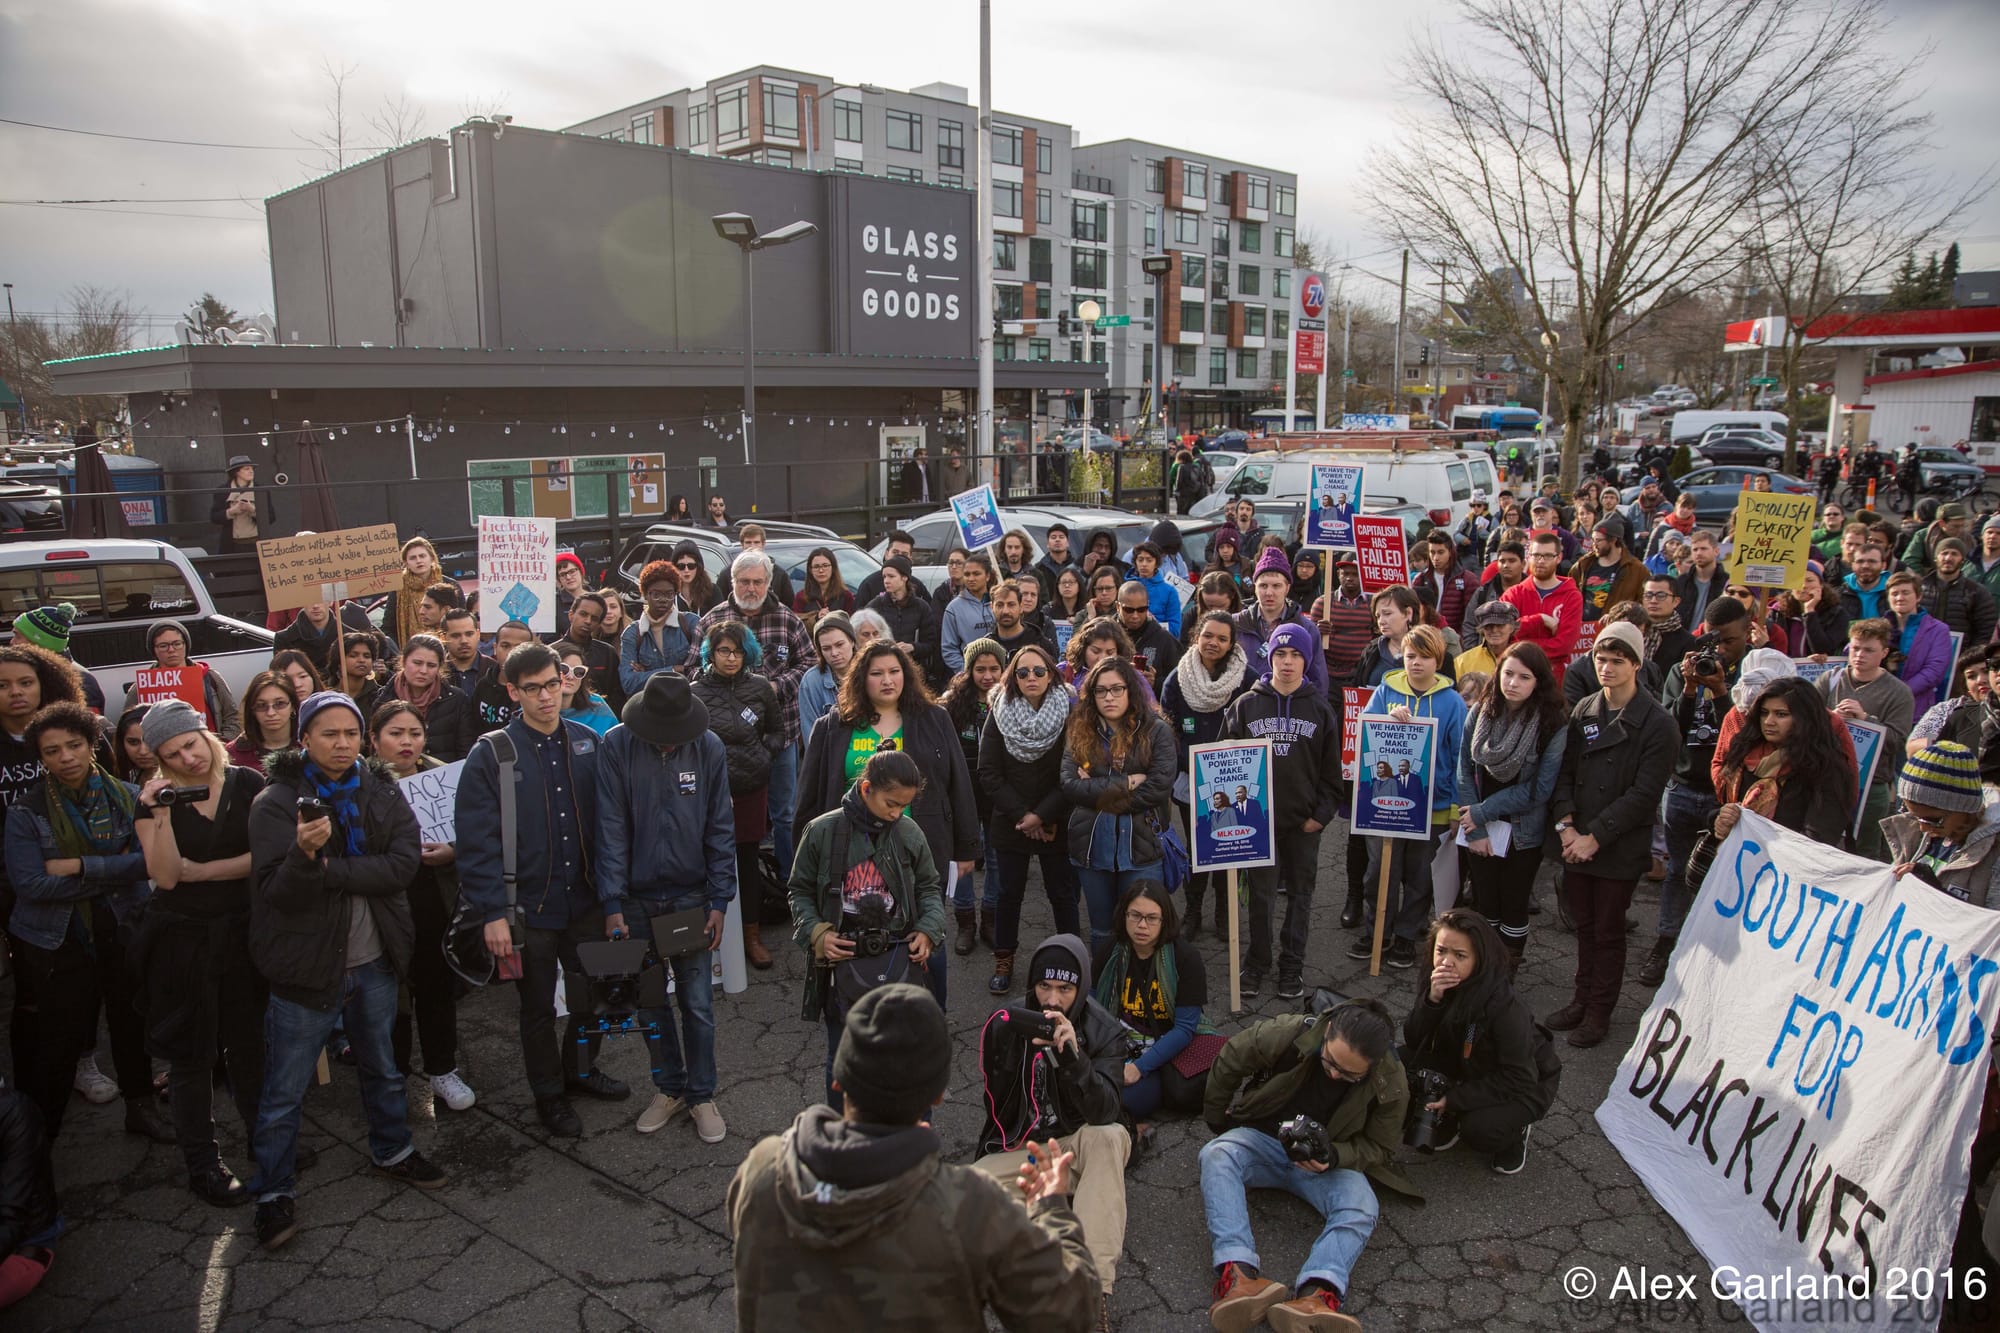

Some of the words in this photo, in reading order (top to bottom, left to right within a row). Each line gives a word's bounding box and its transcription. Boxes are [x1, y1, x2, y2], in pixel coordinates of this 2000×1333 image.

[863, 225, 957, 261] GLASS
[907, 264, 918, 283] &
[863, 288, 959, 320] GOODS
[124, 502, 152, 513] ONAL
[1745, 497, 1811, 524] DEMOLISH
[1357, 524, 1399, 537] CAPITALISM
[1746, 519, 1804, 543] POVERTY
[261, 542, 305, 558] Education
[309, 537, 342, 550] without
[1371, 537, 1387, 548] HAS
[1754, 537, 1774, 548] NOT
[268, 563, 277, 572] is
[291, 553, 333, 568] one-sided
[366, 545, 398, 557] because
[1361, 548, 1402, 567] FAILED
[1734, 544, 1795, 567] PEOPLE
[280, 574, 297, 586] has
[303, 573, 315, 581] no
[1363, 566, 1381, 580] THE
[1381, 568, 1404, 582] 99%
[1277, 635, 1292, 645] W
[138, 670, 183, 689] BLACK
[1344, 689, 1358, 704] NO
[1247, 717, 1317, 739] WASHINGTON
[1370, 723, 1383, 731] WE
[1385, 724, 1406, 732] HAVE
[1408, 725, 1424, 733] THE
[1265, 733, 1298, 742] HUSKIES
[1375, 731, 1405, 740] POWER
[1407, 733, 1418, 741] TO
[1273, 743, 1291, 756] W
[1385, 740, 1408, 748] MAKE
[1203, 753, 1216, 761] WE
[1217, 750, 1240, 760] HAVE
[1242, 748, 1259, 757] THE
[1379, 747, 1413, 756] CHANGE
[1208, 759, 1239, 768] POWER
[1241, 757, 1252, 765] TO
[1219, 766, 1243, 775] MAKE
[1214, 773, 1249, 784] CHANGE
[408, 770, 457, 805] ACK
[1377, 799, 1392, 807] MLK
[1217, 830, 1234, 838] MLK
[1234, 828, 1251, 836] DAY
[1714, 840, 1864, 988] SOUTH
[1845, 902, 2000, 1065] ASIANS
[1766, 993, 1864, 1121] FOR
[1629, 1008, 1779, 1195] BLACK
[1761, 1117, 1886, 1295] LIVES
